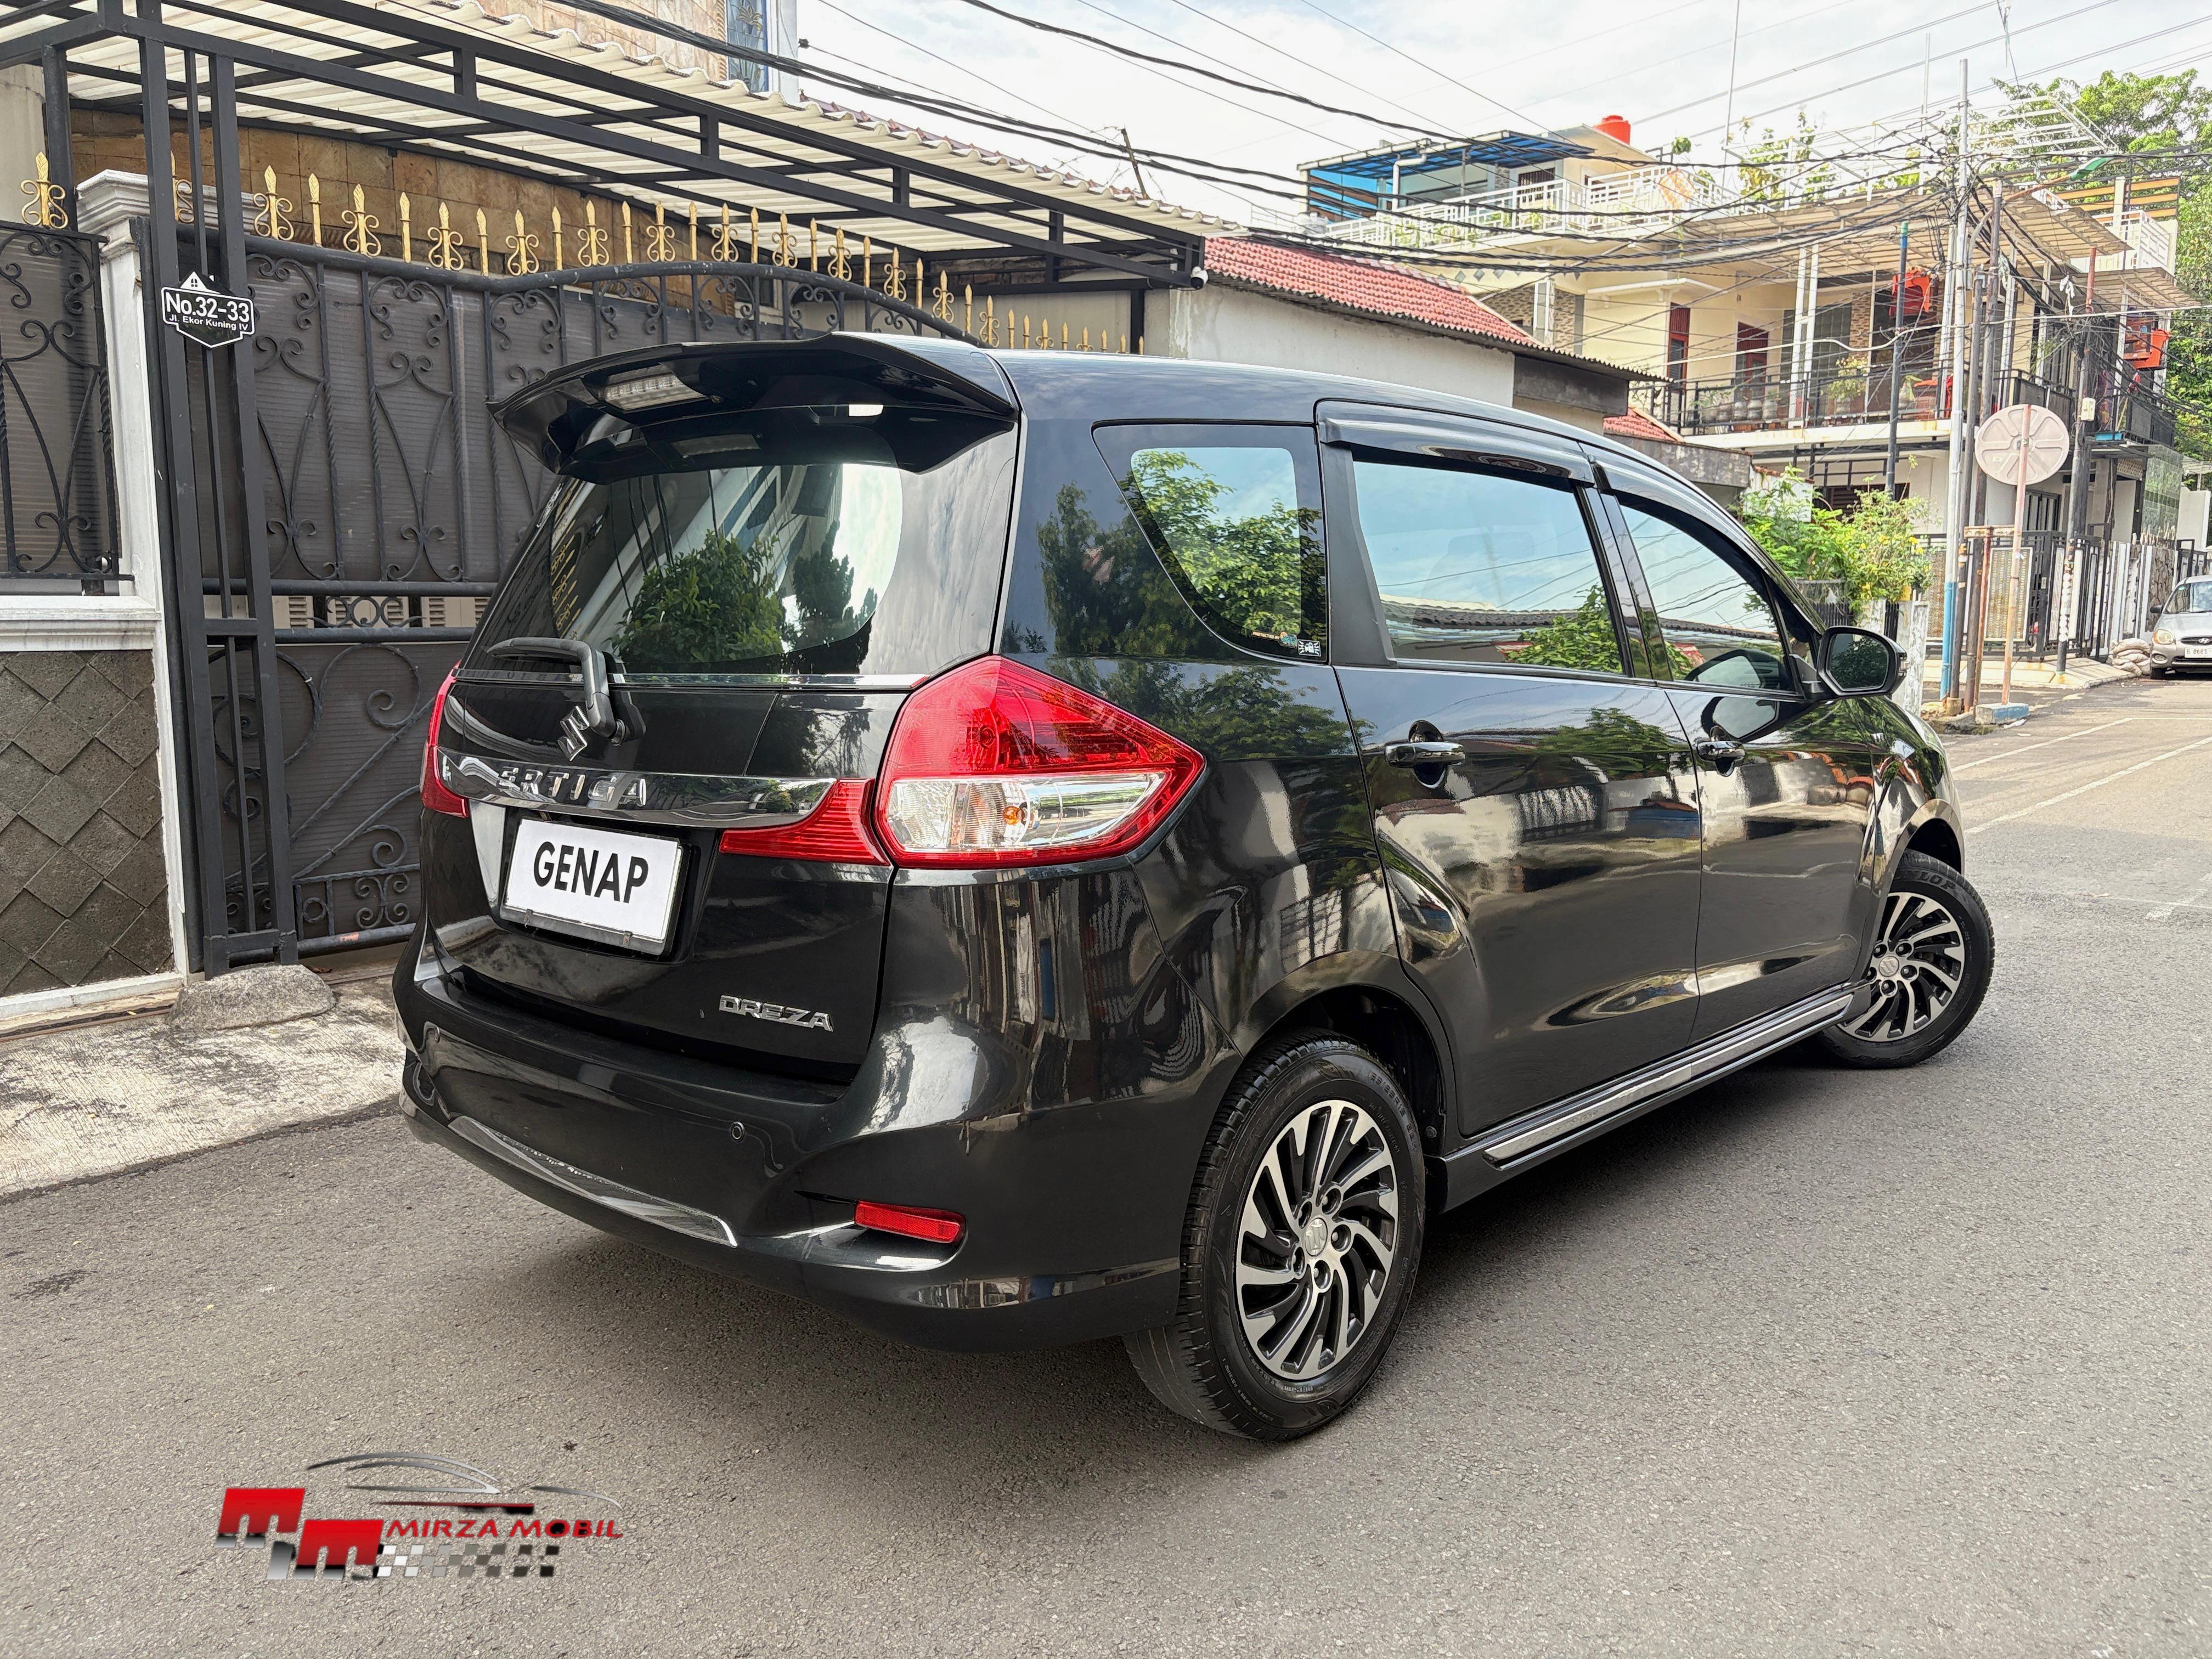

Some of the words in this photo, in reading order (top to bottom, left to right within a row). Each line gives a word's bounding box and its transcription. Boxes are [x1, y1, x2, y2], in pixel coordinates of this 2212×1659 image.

[165, 292, 250, 323] No.32-33
[169, 314, 180, 322] Jl.
[182, 315, 204, 325] Ekor
[206, 319, 237, 331] Kuning
[496, 766, 647, 807] ERTIGA
[533, 841, 649, 904] GENAP
[719, 994, 834, 1032] DREZA
